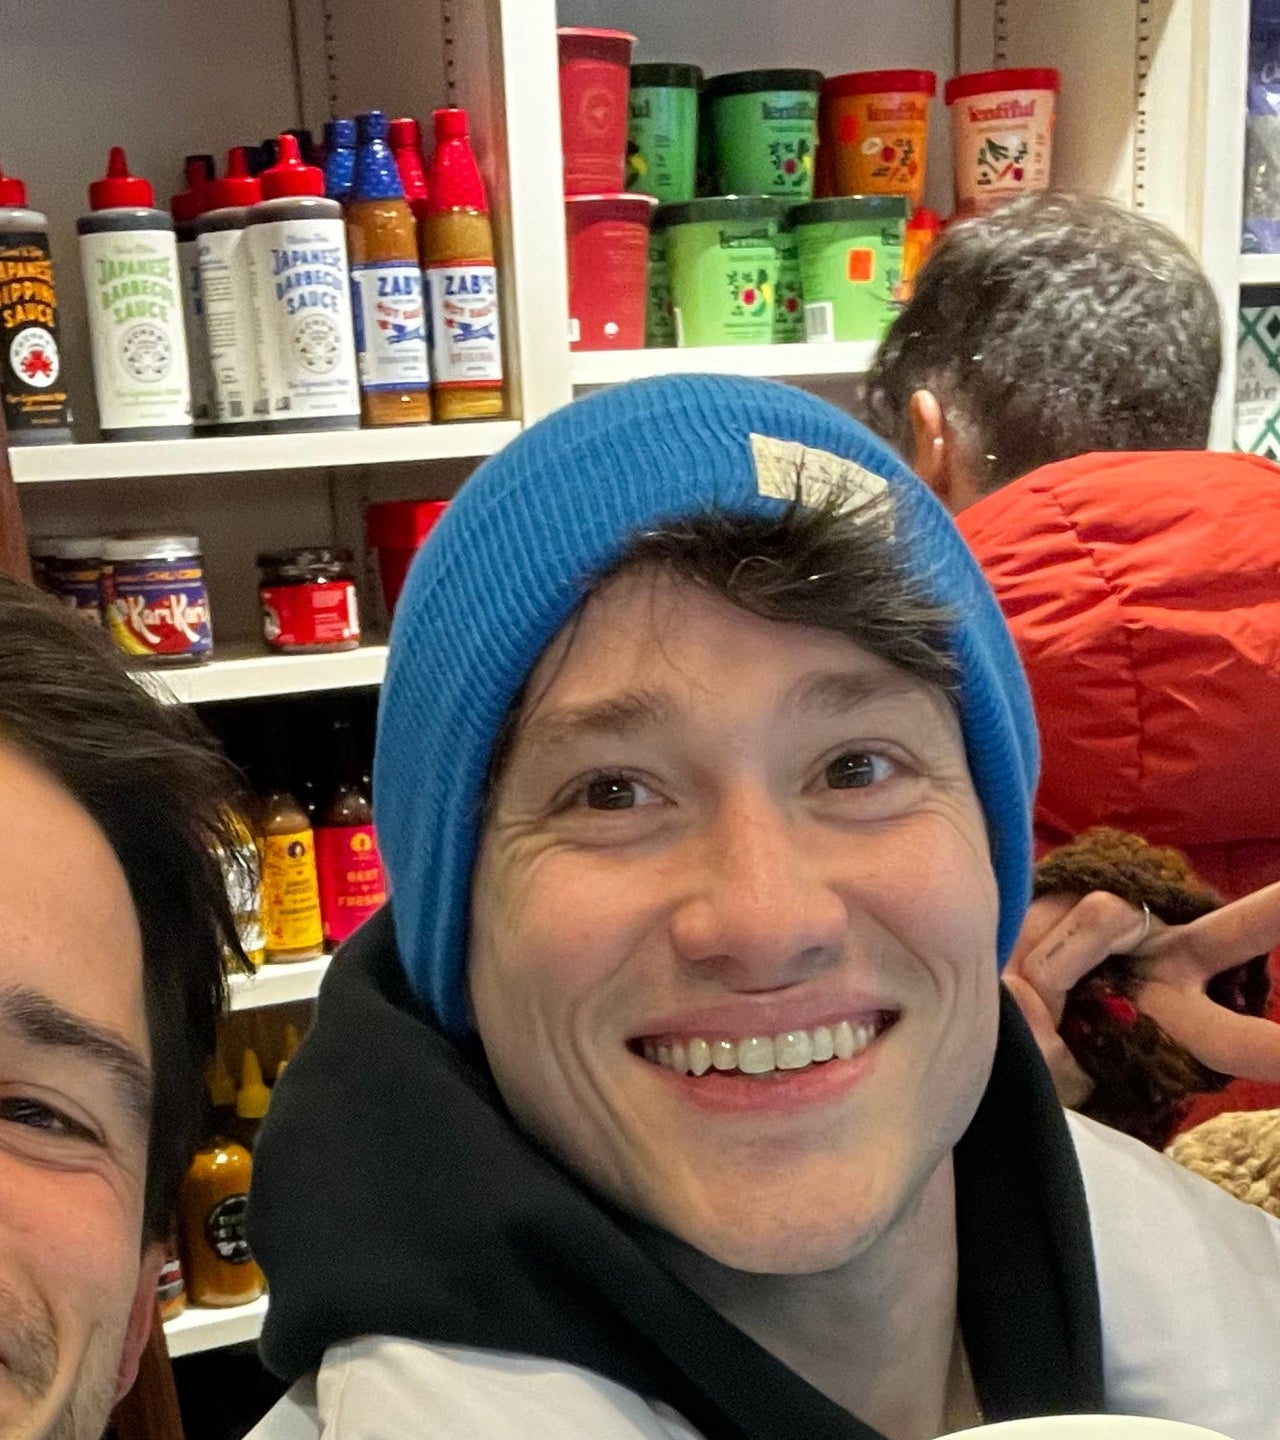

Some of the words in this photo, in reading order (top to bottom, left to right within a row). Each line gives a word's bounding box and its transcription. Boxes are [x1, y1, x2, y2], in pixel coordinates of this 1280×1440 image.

[444, 274, 494, 296] ZAB'S
[113, 301, 169, 325] SAUCE
[287, 291, 339, 315] SAUCE
